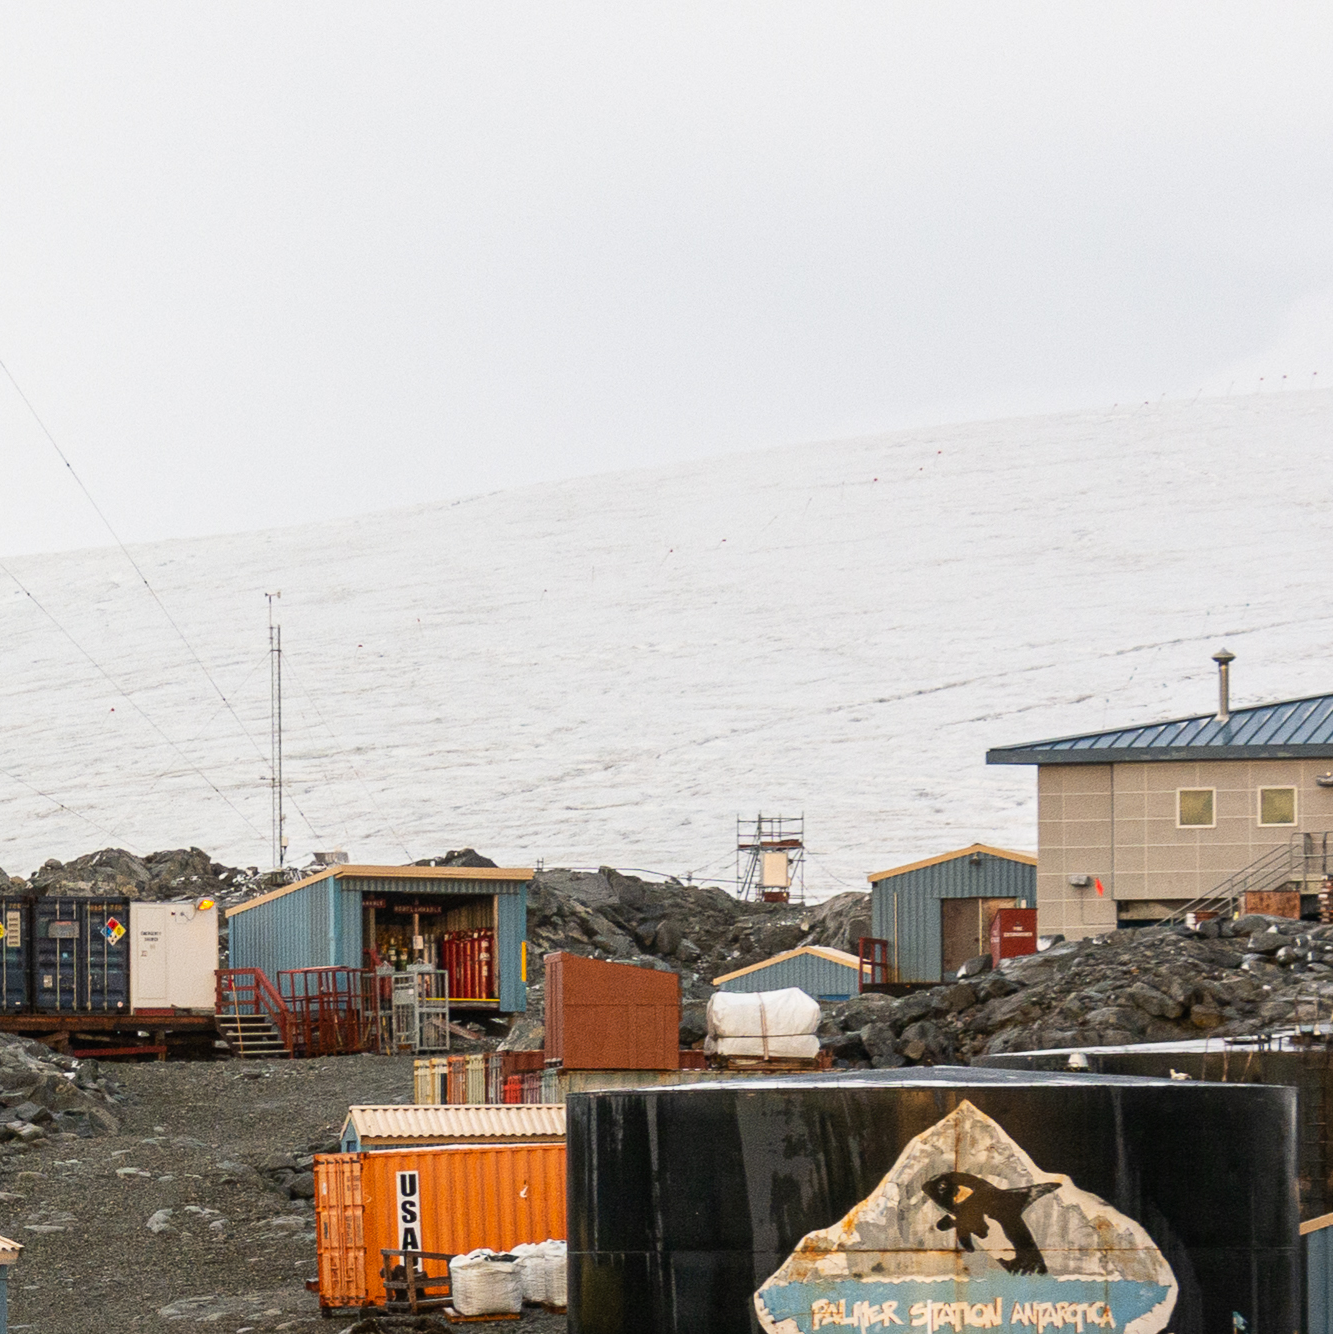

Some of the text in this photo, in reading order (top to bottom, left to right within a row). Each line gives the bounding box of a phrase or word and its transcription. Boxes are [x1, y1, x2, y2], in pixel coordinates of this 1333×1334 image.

[811, 1297, 1116, 1334] PALMER STATION ANTARCTICA
